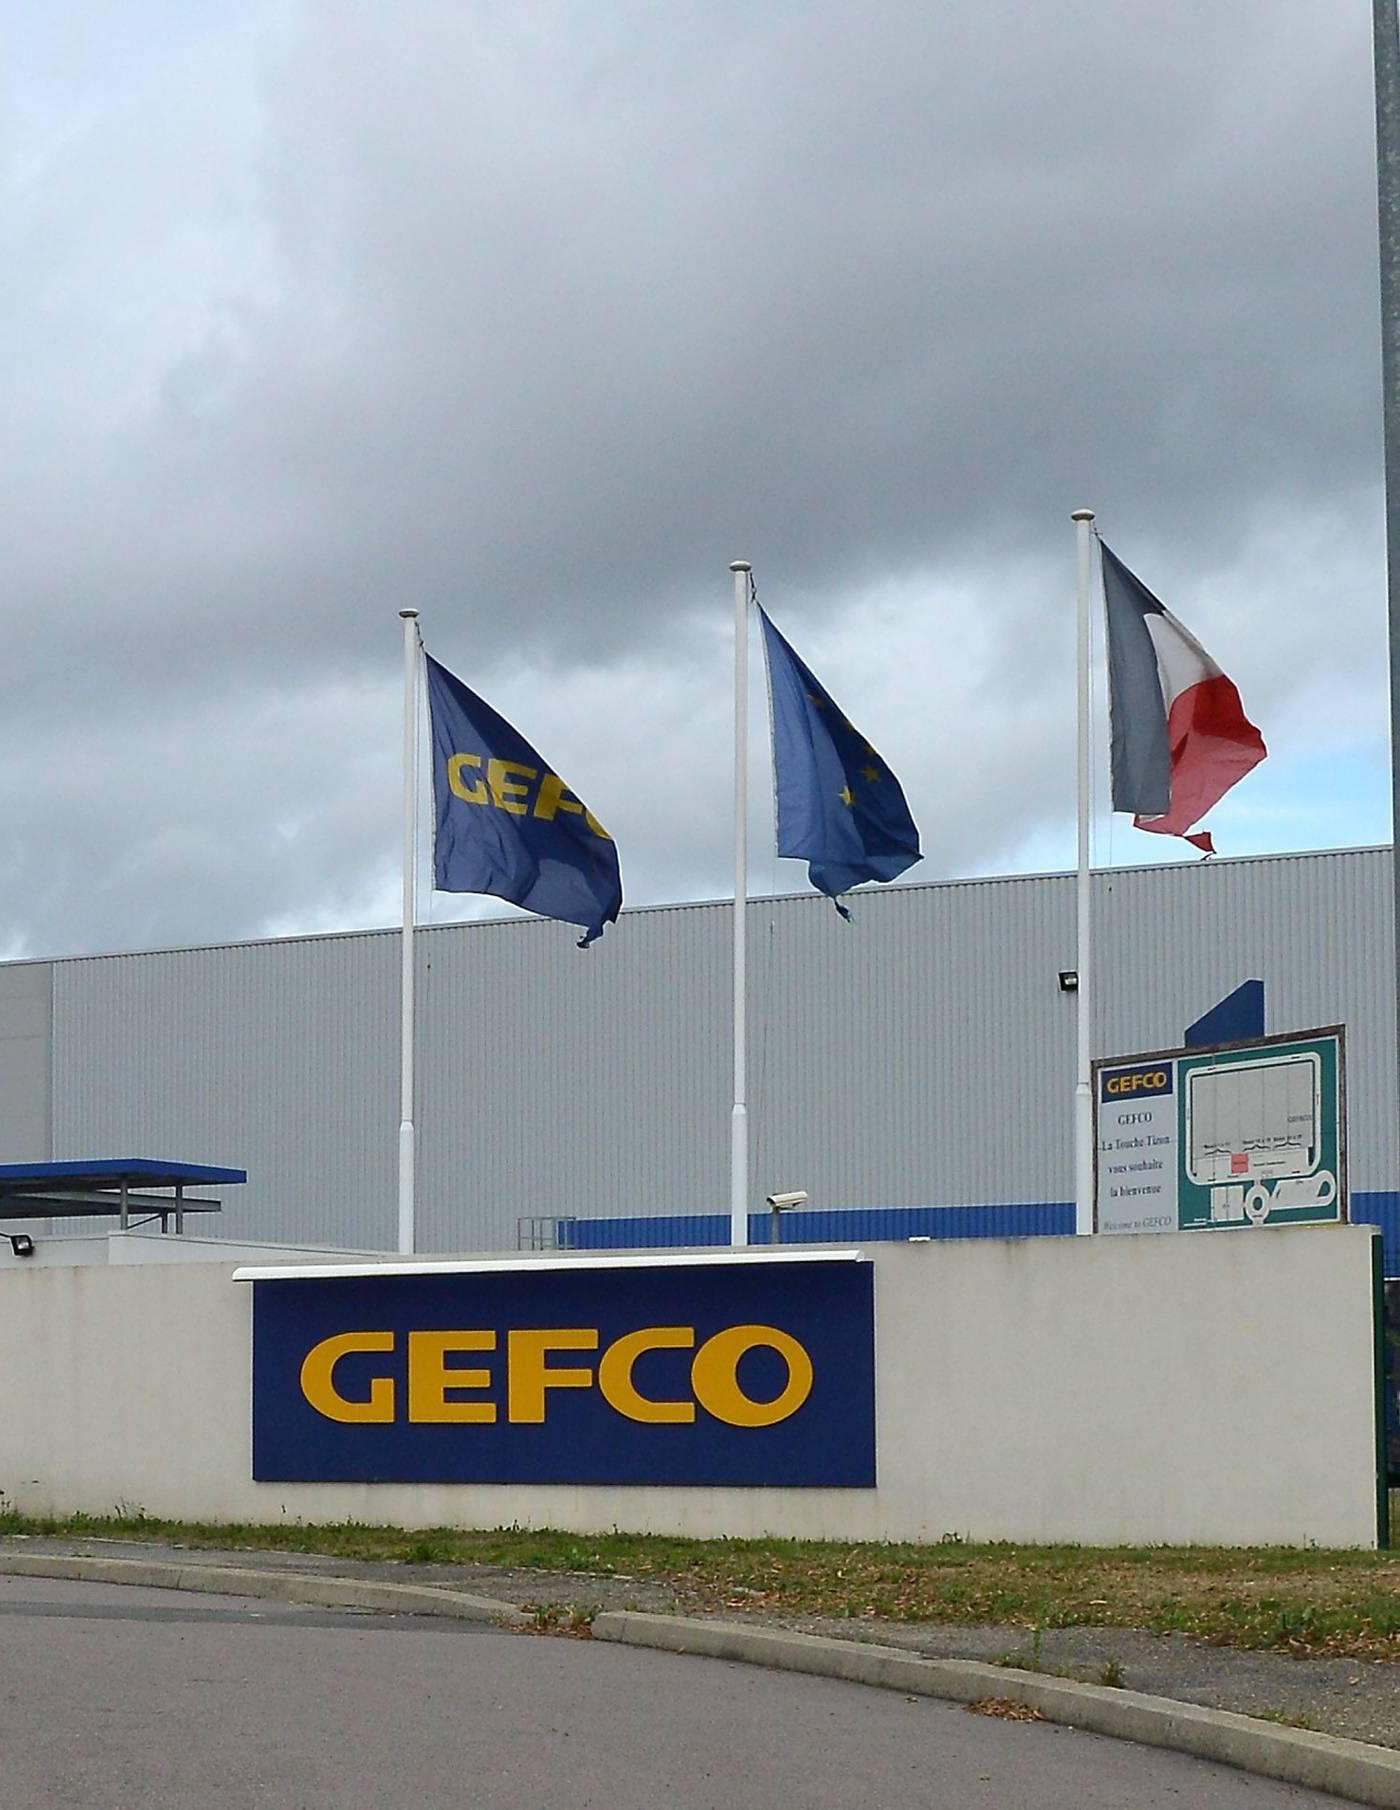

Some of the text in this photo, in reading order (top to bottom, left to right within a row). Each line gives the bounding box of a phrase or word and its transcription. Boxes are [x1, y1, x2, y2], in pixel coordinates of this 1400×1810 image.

[1107, 1072, 1167, 1093] GEFCO
[1118, 1112, 1152, 1125] GEFCO
[1102, 1141, 1112, 1151] La
[300, 1324, 814, 1428] GEFCO
